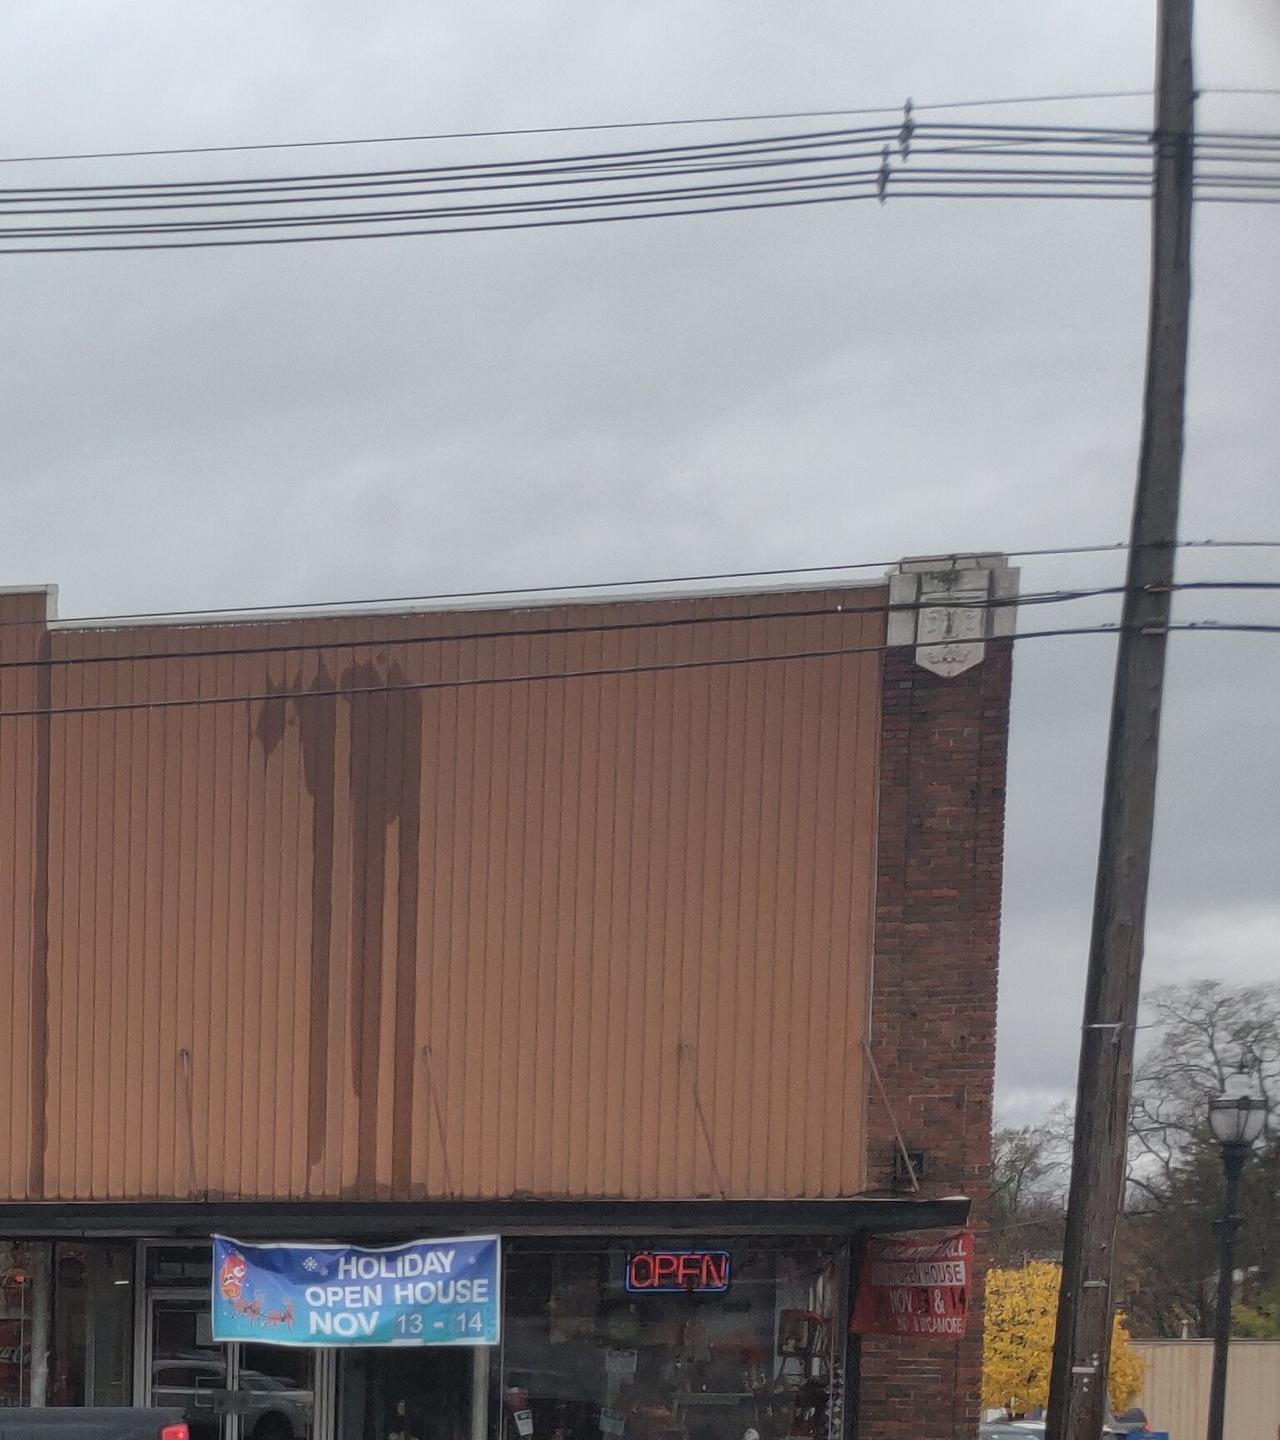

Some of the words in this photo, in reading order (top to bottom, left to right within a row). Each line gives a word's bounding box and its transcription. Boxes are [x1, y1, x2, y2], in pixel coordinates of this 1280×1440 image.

[338, 1250, 455, 1280] HOLIDAY
[631, 1254, 726, 1288] OPEN
[305, 1284, 383, 1308] OPEN
[394, 1279, 489, 1305] HOUSE
[309, 1311, 380, 1336] NOV
[397, 1312, 424, 1333] 13
[456, 1311, 483, 1333] 14
